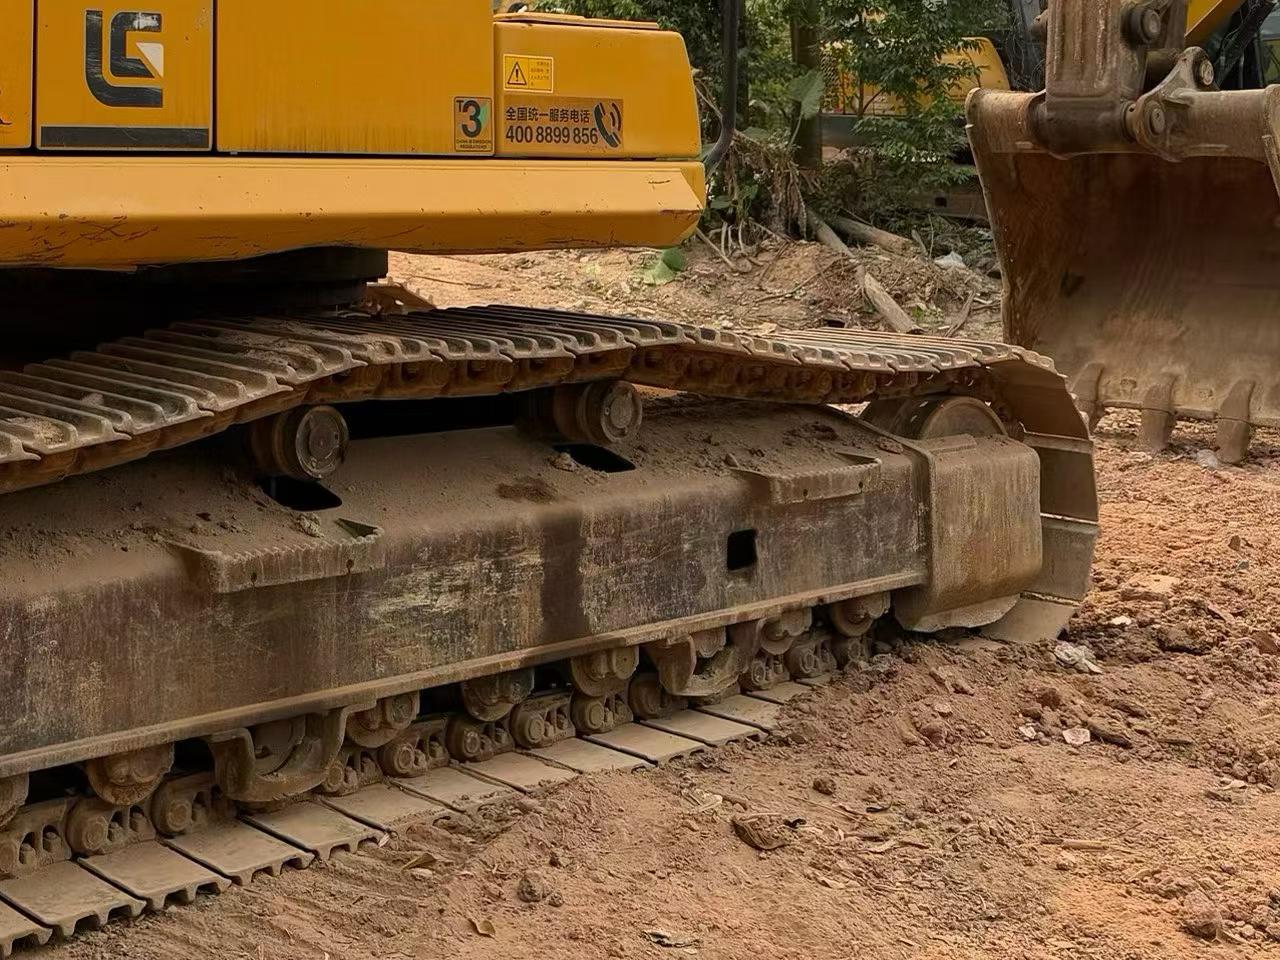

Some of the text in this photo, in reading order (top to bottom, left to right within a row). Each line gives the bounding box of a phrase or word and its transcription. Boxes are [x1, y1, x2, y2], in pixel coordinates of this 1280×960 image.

[505, 106, 591, 124] 全国统一服务电话
[505, 125, 599, 145] 400 8899 856
